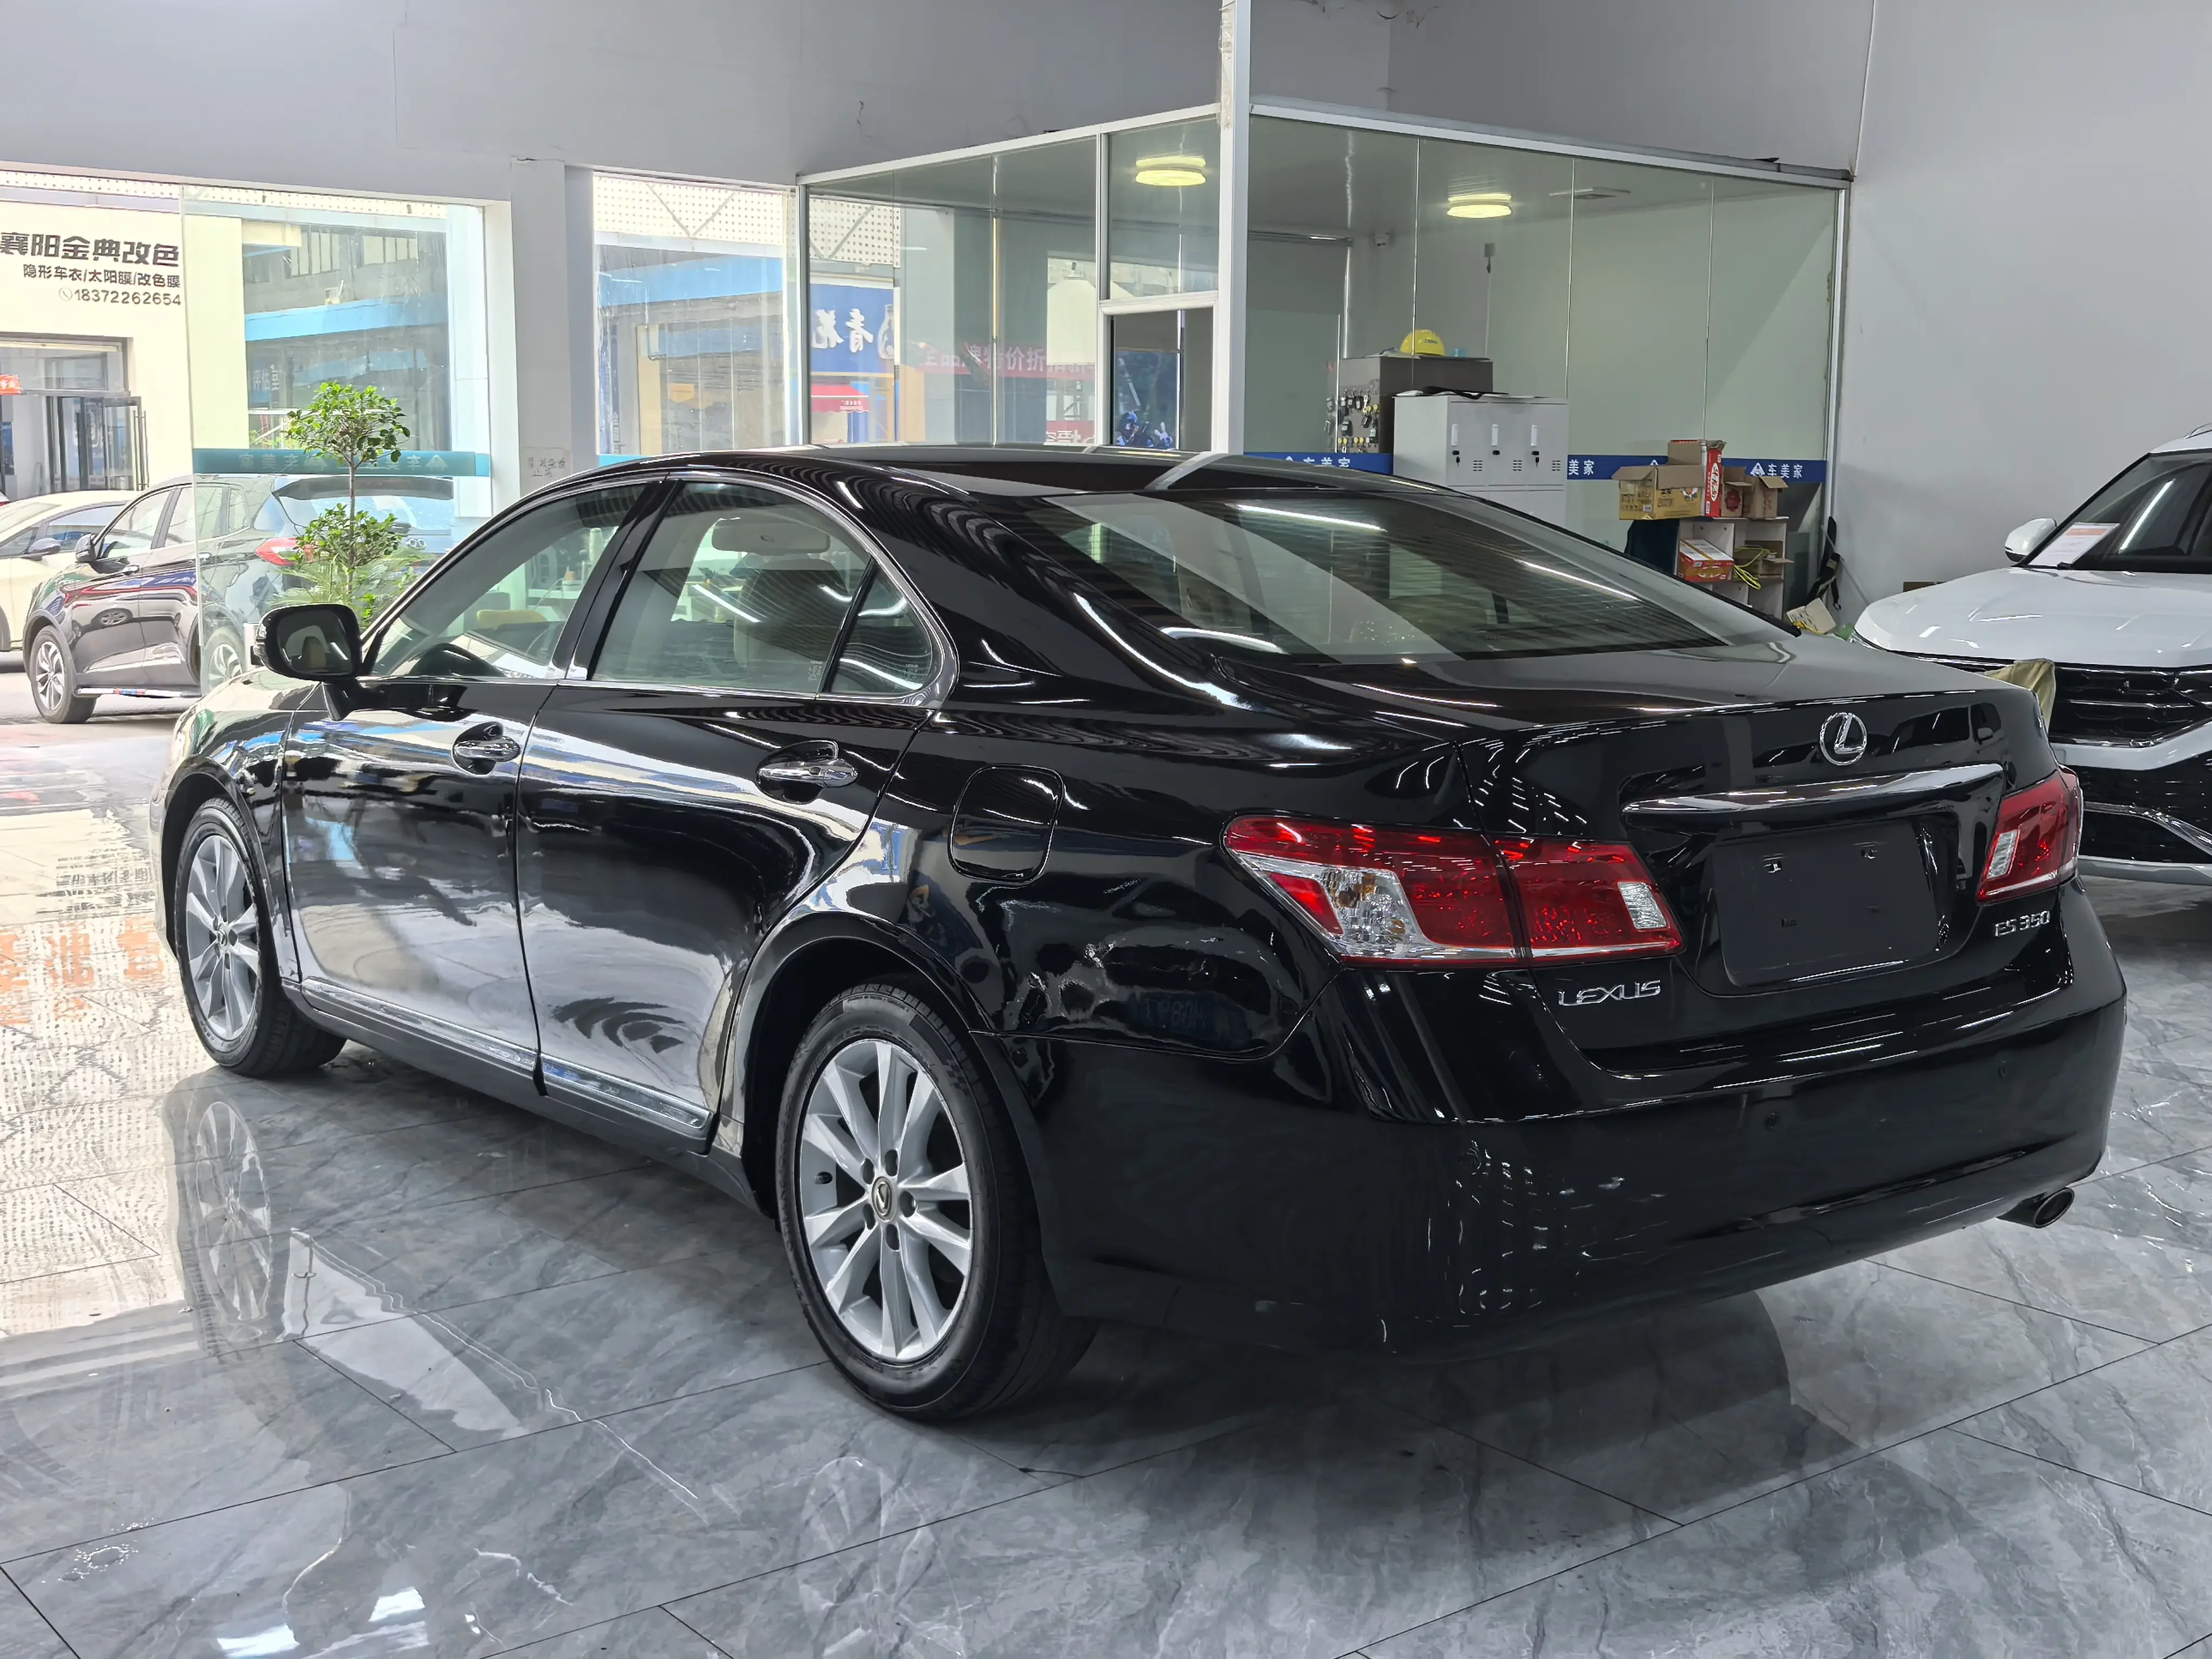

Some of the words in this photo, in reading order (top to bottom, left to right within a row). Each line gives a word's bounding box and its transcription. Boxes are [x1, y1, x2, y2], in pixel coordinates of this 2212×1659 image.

[0, 232, 179, 267] 襄阳金典改色
[74, 289, 181, 306] 18372262654
[1568, 459, 1595, 476] 美家
[1767, 463, 1803, 479] 车美家
[1994, 919, 2017, 937] ES
[2019, 911, 2051, 930] 350
[1557, 979, 1661, 1006] LEXUS
